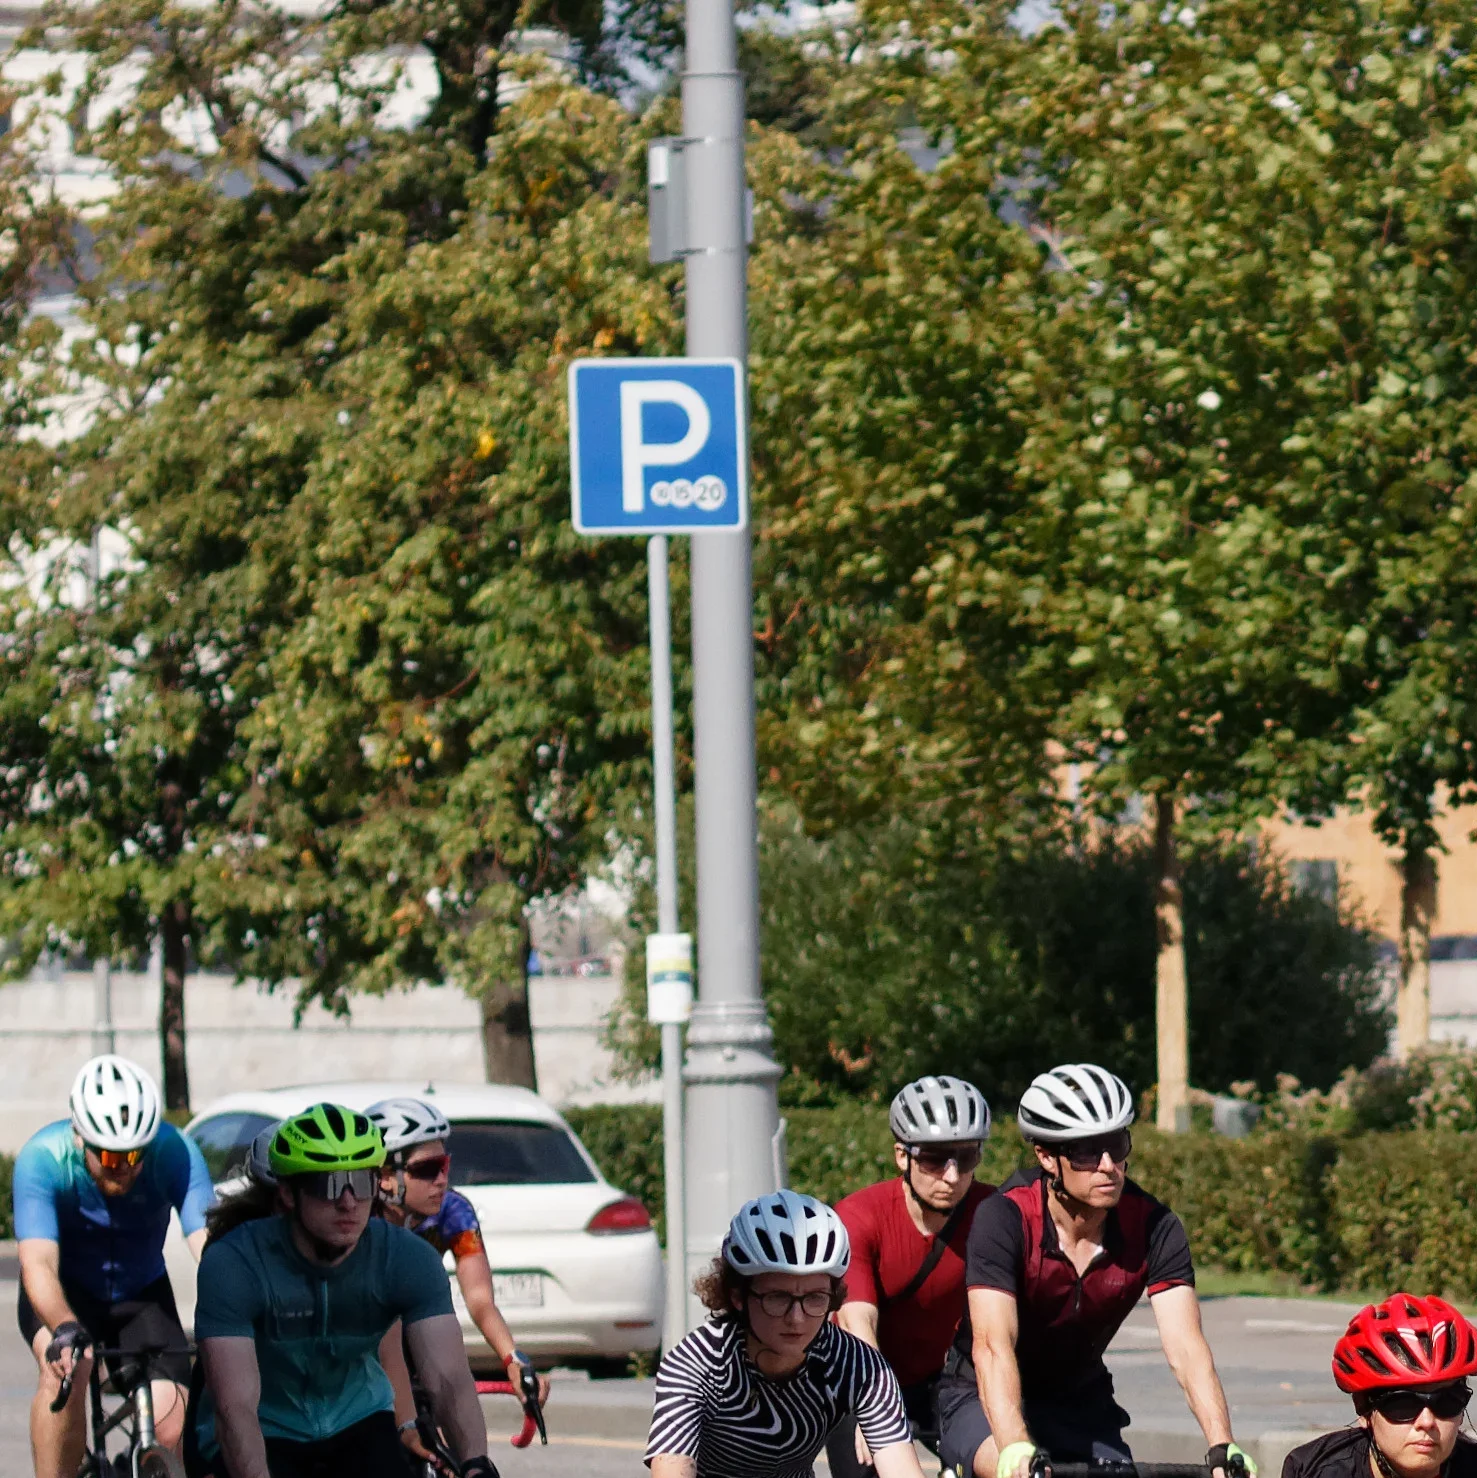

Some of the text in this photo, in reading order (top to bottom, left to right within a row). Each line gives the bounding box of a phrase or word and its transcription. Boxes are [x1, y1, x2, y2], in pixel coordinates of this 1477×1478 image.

[620, 379, 711, 512] P
[675, 486, 691, 499] 15
[697, 483, 722, 501] 20
